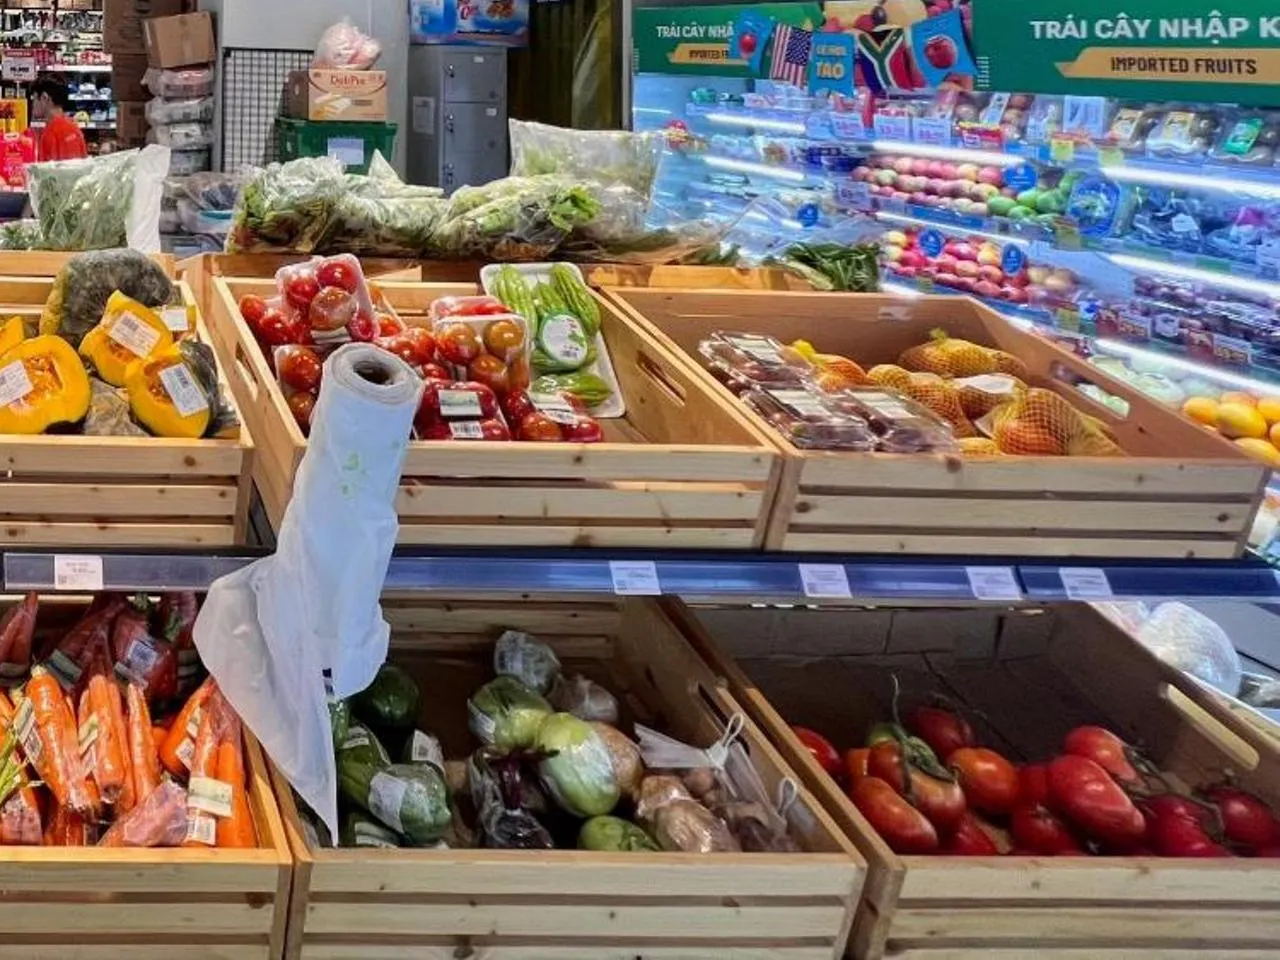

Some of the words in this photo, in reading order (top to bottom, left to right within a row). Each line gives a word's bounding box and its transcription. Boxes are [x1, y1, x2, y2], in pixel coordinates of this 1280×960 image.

[656, 21, 681, 38] TRÁI
[682, 20, 707, 38] CÂY
[1029, 13, 1087, 40] TRÁI
[1094, 11, 1151, 40] CÂY
[1159, 8, 1250, 44] NHẬP
[1111, 56, 1190, 74] IMPORTED
[1195, 57, 1258, 76] FRUITS
